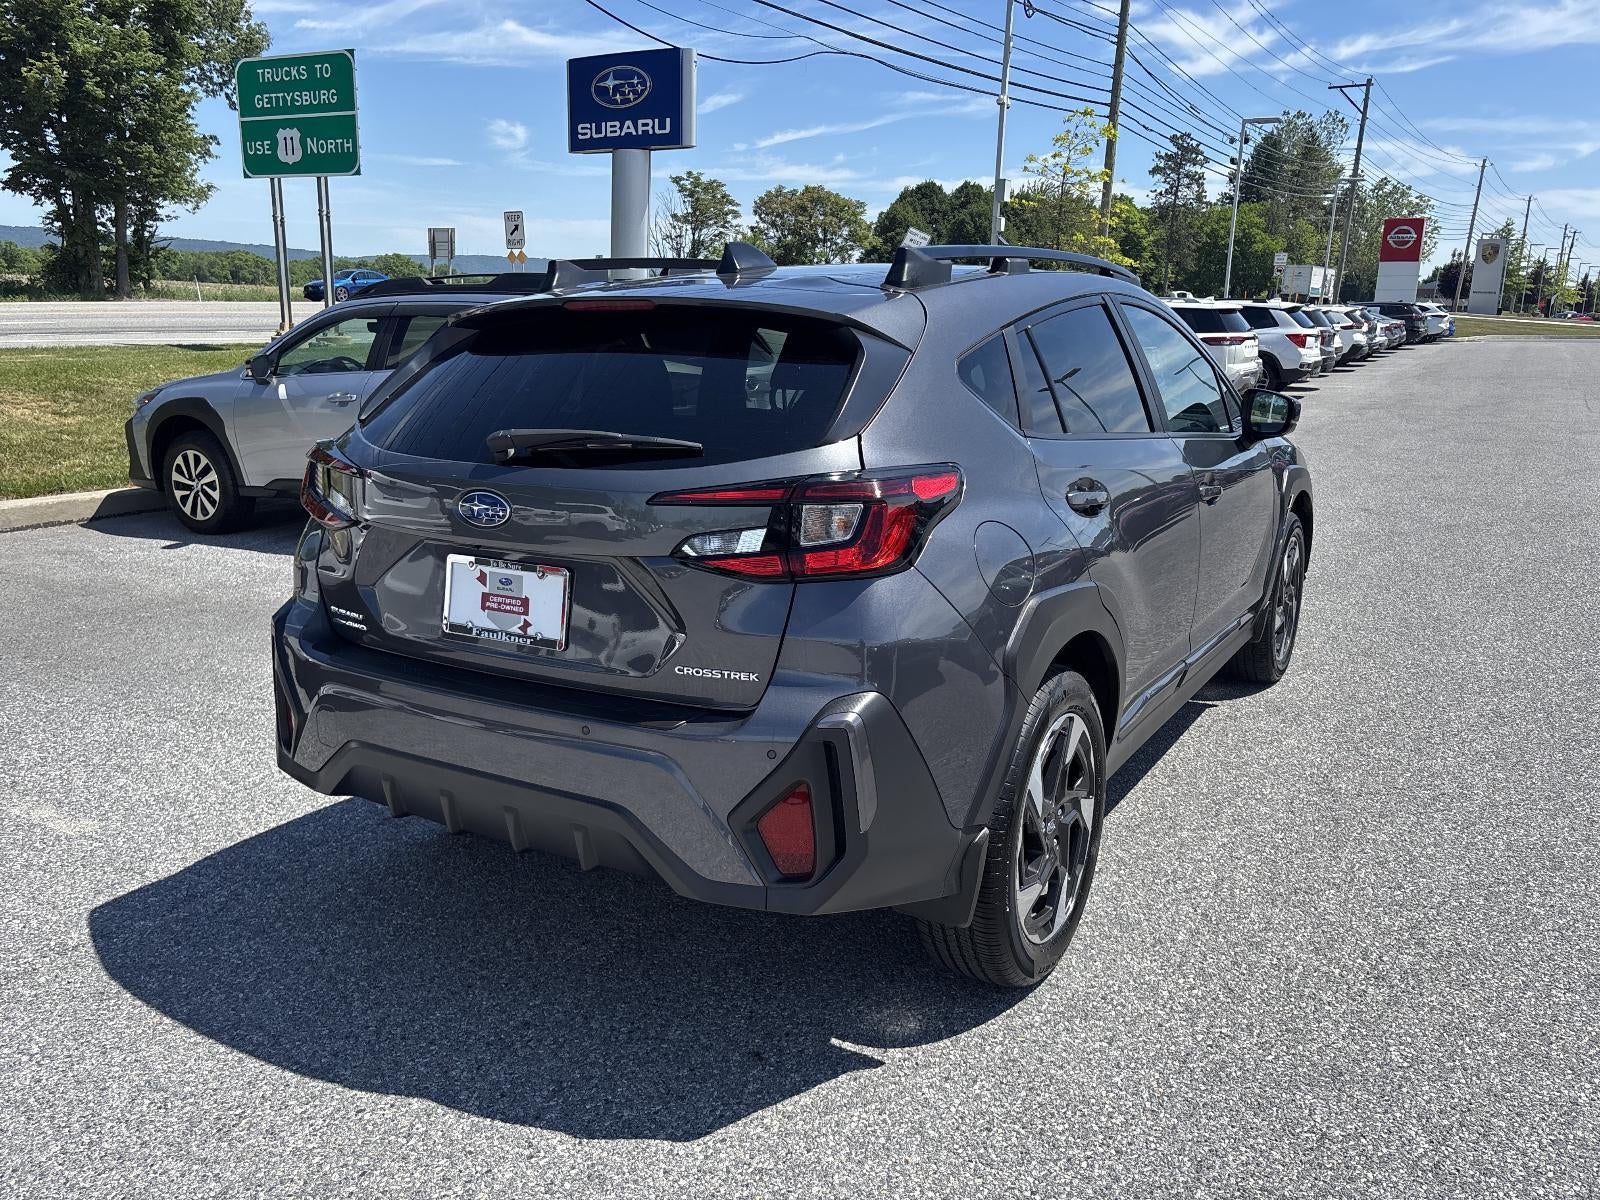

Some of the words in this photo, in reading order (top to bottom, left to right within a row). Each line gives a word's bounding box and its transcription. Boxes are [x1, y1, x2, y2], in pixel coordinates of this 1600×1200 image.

[257, 66, 307, 82] TRUCKS
[315, 64, 331, 78] TO
[255, 89, 337, 108] GETTYSBURG
[577, 117, 671, 140] SUBARU
[247, 141, 272, 155] USE
[283, 136, 295, 156] 11
[507, 214, 521, 222] KEEP
[507, 238, 523, 246] RIGHT
[498, 562, 507, 570] Be
[485, 602, 524, 613] PRE-OWNED
[489, 596, 522, 606] CERTIFIED
[330, 605, 364, 620] SUBARU
[346, 621, 367, 631] AWD
[472, 627, 534, 645] Faulkner
[674, 665, 760, 682] CROSSTREK
